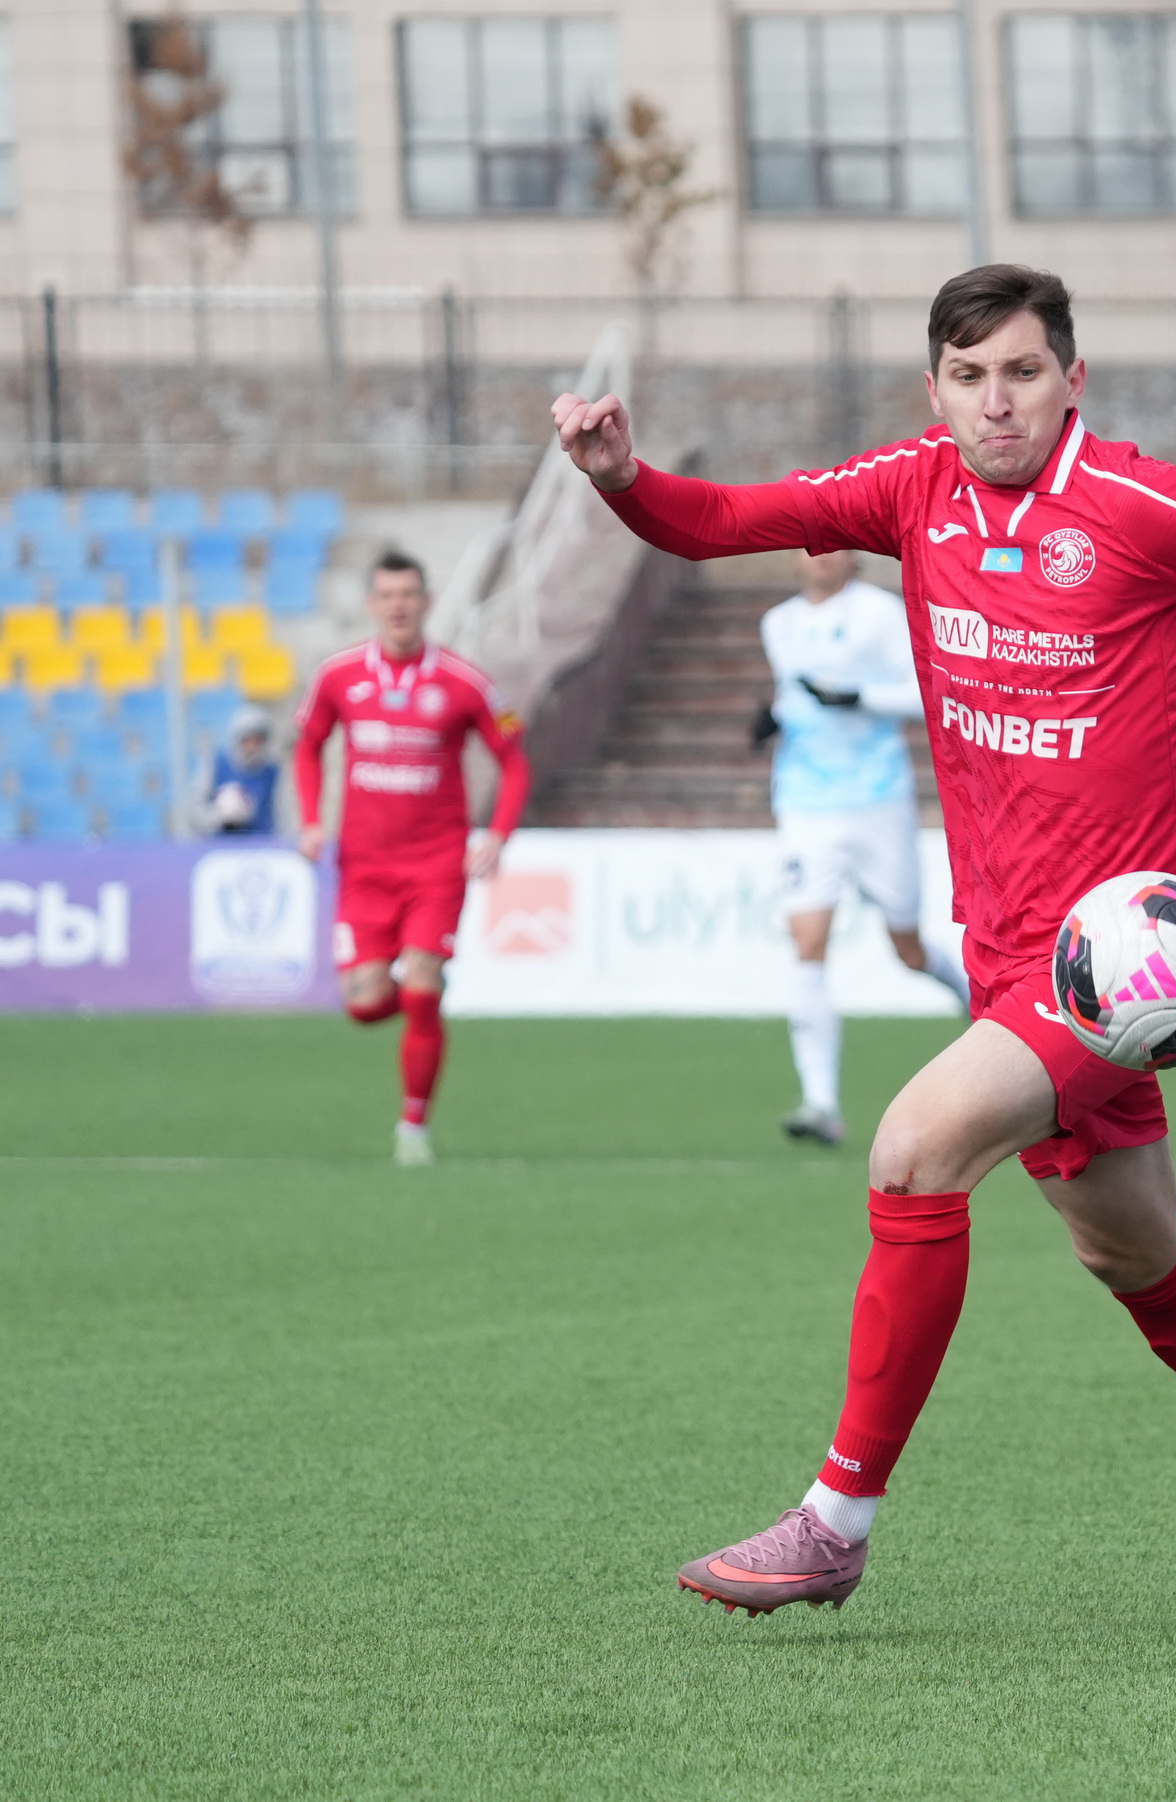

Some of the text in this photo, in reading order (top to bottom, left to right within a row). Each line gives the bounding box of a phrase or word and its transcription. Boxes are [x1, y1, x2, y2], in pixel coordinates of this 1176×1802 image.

[1045, 566, 1089, 584] PETROPAVL
[992, 624, 1095, 650] RARE METALS
[991, 642, 1095, 668] KAZAKHSTAN
[950, 674, 1053, 697] SPIRIT OF THE NORTH
[942, 695, 1098, 760] FONBET
[828, 1444, 862, 1473] oma
